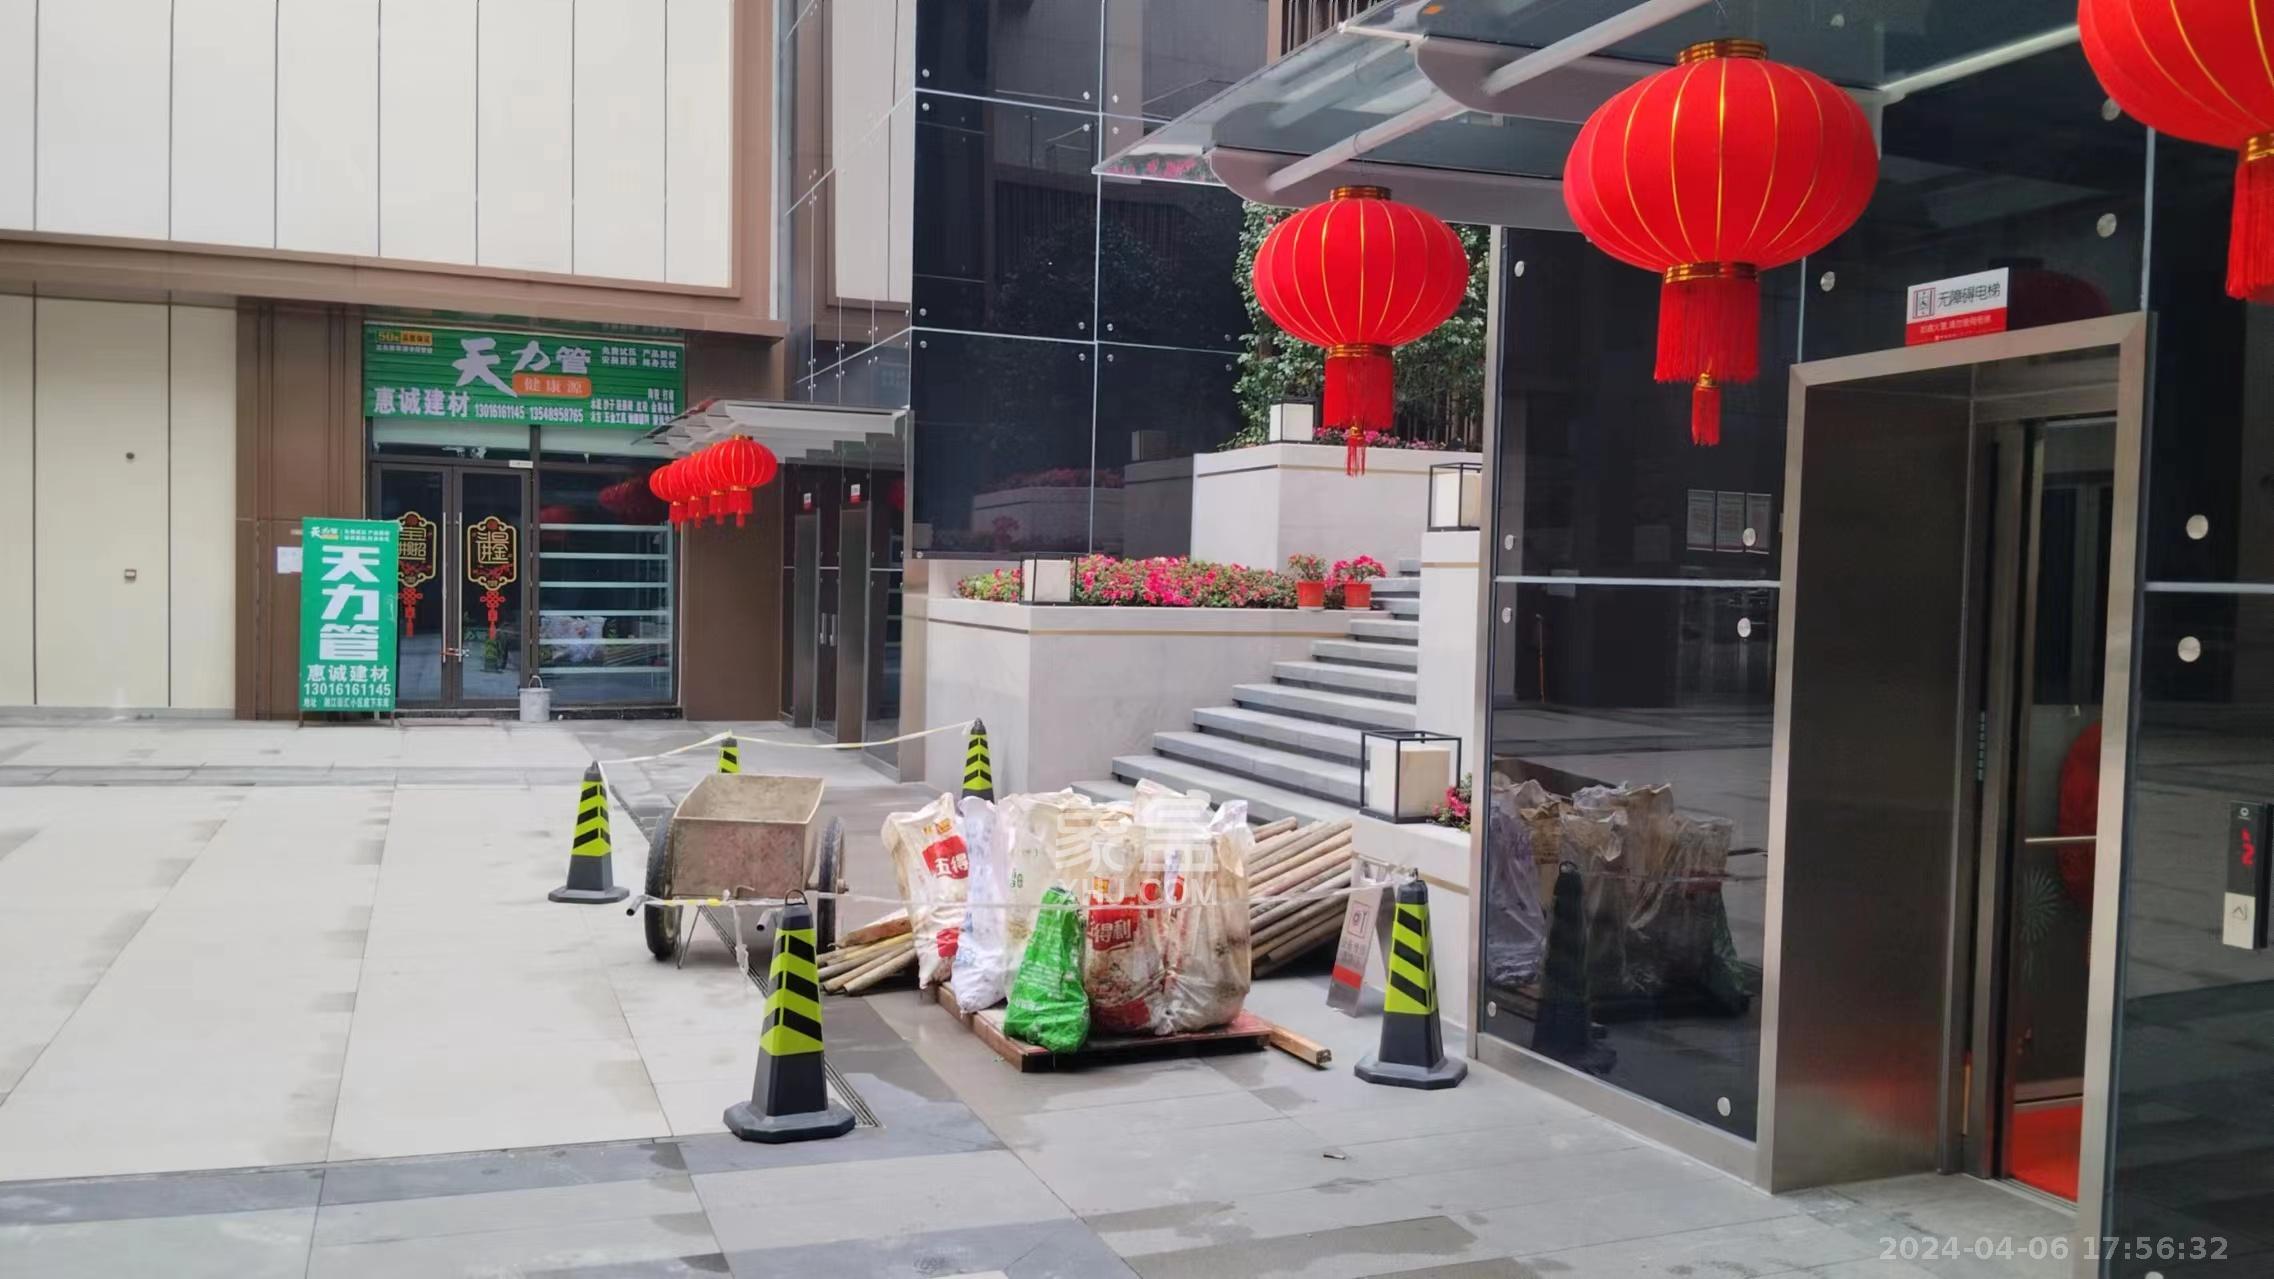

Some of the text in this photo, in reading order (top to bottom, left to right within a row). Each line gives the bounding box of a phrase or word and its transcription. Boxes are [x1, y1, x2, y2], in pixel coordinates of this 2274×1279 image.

[1938, 283, 2001, 307] 无障碍电梯
[452, 337, 592, 398] 天力管
[524, 377, 583, 394] 健康源
[374, 386, 470, 418] 惠诚建材
[475, 403, 525, 419] 13016161145
[320, 545, 380, 661] 天力管
[307, 664, 389, 682] 惠诚建材
[304, 683, 391, 696] 13016161145
